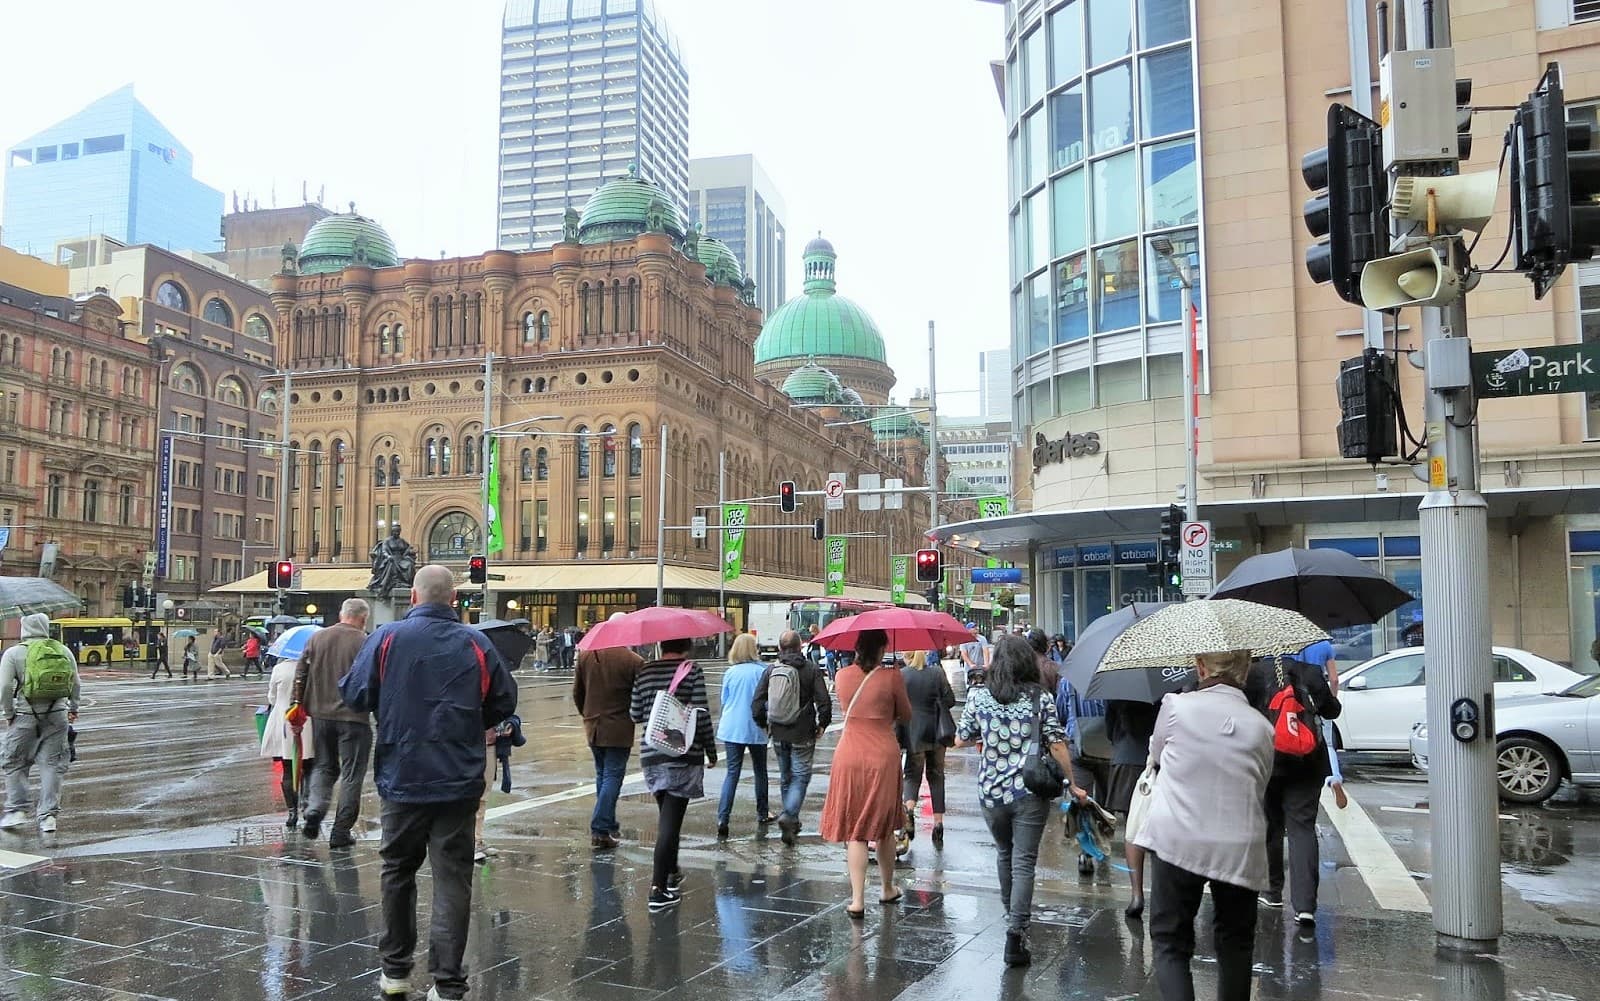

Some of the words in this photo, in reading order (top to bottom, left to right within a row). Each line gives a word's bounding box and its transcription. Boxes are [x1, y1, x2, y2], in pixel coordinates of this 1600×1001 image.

[1528, 351, 1595, 379] Park
[1548, 381, 1561, 391] 17
[1121, 549, 1157, 560] citibank
[1188, 549, 1204, 558] NO
